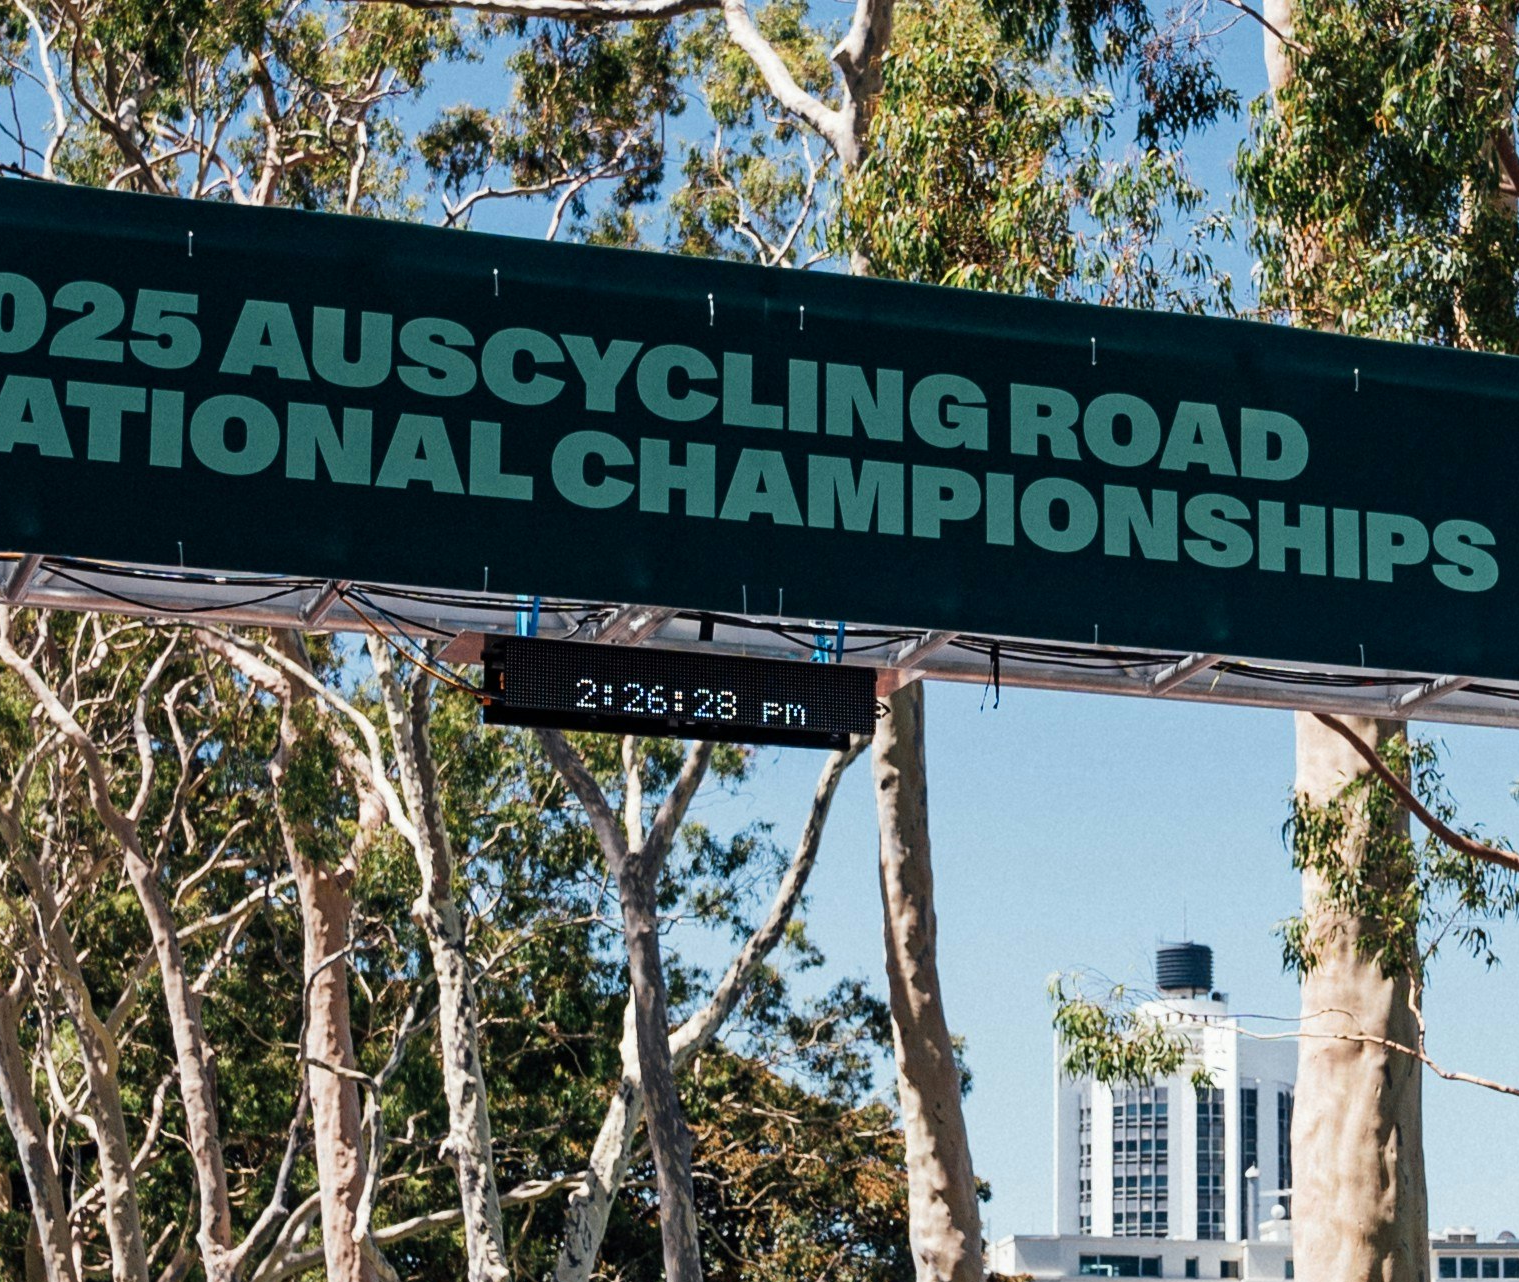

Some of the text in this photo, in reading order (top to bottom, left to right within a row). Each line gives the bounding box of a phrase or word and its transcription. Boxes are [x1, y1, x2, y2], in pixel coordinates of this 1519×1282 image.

[219, 299, 988, 450] AUSCYCLING
[1010, 382, 1309, 481] ROAD
[551, 430, 1499, 592] CHAMPIONSHIPS
[576, 679, 806, 726] 2:26:28 PM
